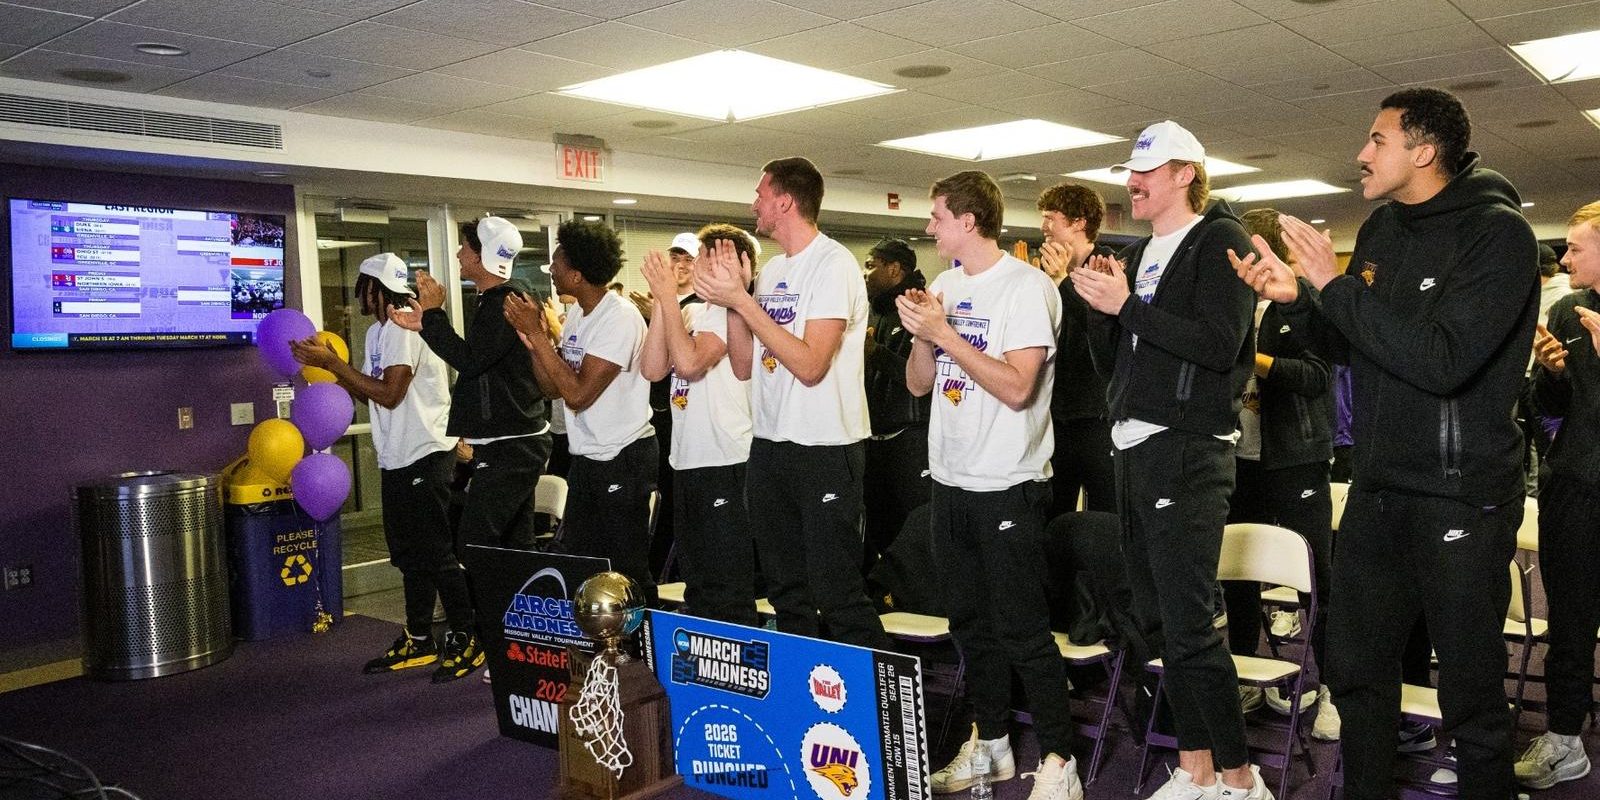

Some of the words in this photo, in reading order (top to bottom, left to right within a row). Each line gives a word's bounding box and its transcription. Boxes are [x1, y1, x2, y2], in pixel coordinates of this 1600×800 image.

[564, 147, 598, 179] EXIT
[943, 379, 966, 392] UNI
[273, 540, 318, 555] RECYCLE
[276, 529, 314, 543] PLEASE
[514, 593, 575, 619] ARCH
[504, 629, 530, 639] MISSOURI
[532, 634, 552, 643] VALLEY
[554, 637, 594, 648] TOURNAMENT
[690, 635, 741, 664] MARCH
[526, 646, 569, 669] StateF
[698, 657, 768, 691] MADNESS
[887, 664, 895, 677] 26
[813, 677, 841, 701] VALLEY
[878, 662, 888, 709] QUALIFIER
[887, 679, 897, 702] SEAT
[705, 723, 738, 742] 2026
[881, 710, 892, 760] AUTOMATIC
[892, 734, 901, 746] 15
[708, 743, 741, 759] TICKET
[810, 743, 859, 769] UNI
[894, 747, 902, 768] ROW
[692, 760, 769, 789] PUNCHED
